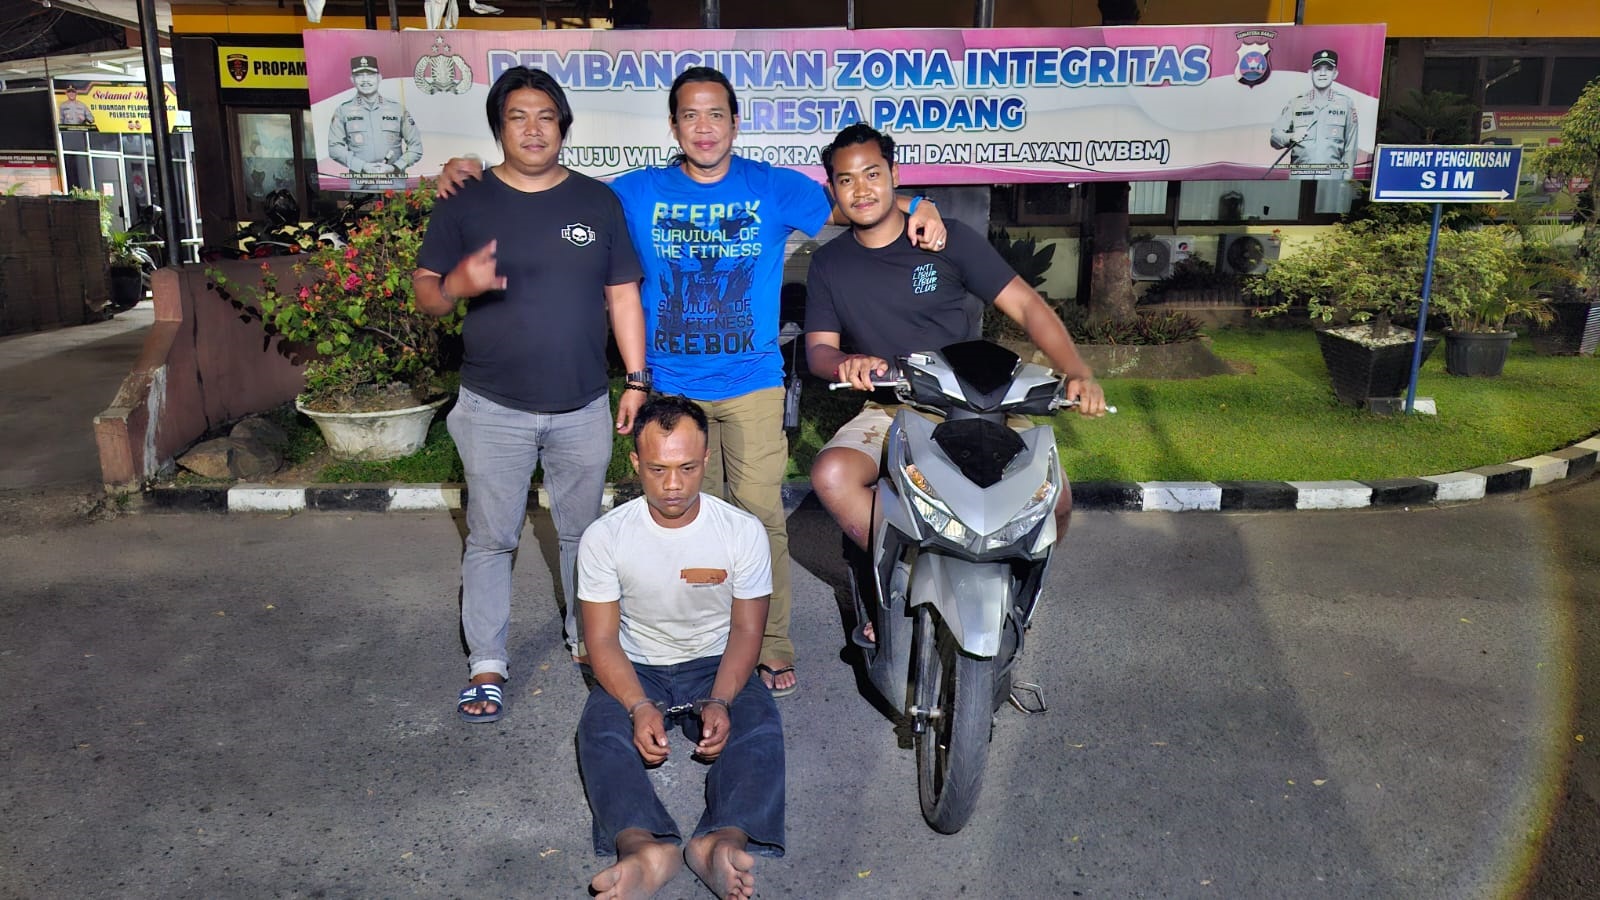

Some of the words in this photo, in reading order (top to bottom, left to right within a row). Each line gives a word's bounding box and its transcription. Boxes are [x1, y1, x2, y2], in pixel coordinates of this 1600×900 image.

[253, 60, 308, 76] PROPAM
[834, 49, 959, 89] ZONA
[964, 46, 1210, 88] INTEGRITAS
[738, 97, 869, 133] LRESTA
[871, 96, 1026, 133] PADANG
[558, 146, 621, 167] NUJU
[623, 146, 686, 167] WILA
[731, 145, 832, 166] IROKRA
[925, 144, 972, 164] DAN
[976, 141, 1082, 163] MELAYANI
[1086, 139, 1171, 165] (WBBM)
[1390, 151, 1433, 167] TEMPAT
[1434, 151, 1512, 168] PENGURUSAN
[1420, 170, 1475, 189] SIM
[652, 229, 732, 242] SURVIVAL
[739, 227, 760, 241] OF
[654, 243, 682, 259] THE
[690, 243, 762, 259] FITNESS
[914, 284, 937, 294] CLUB
[734, 298, 752, 313] OF
[686, 313, 754, 330] FITNESS
[654, 328, 755, 355] REEBOK
